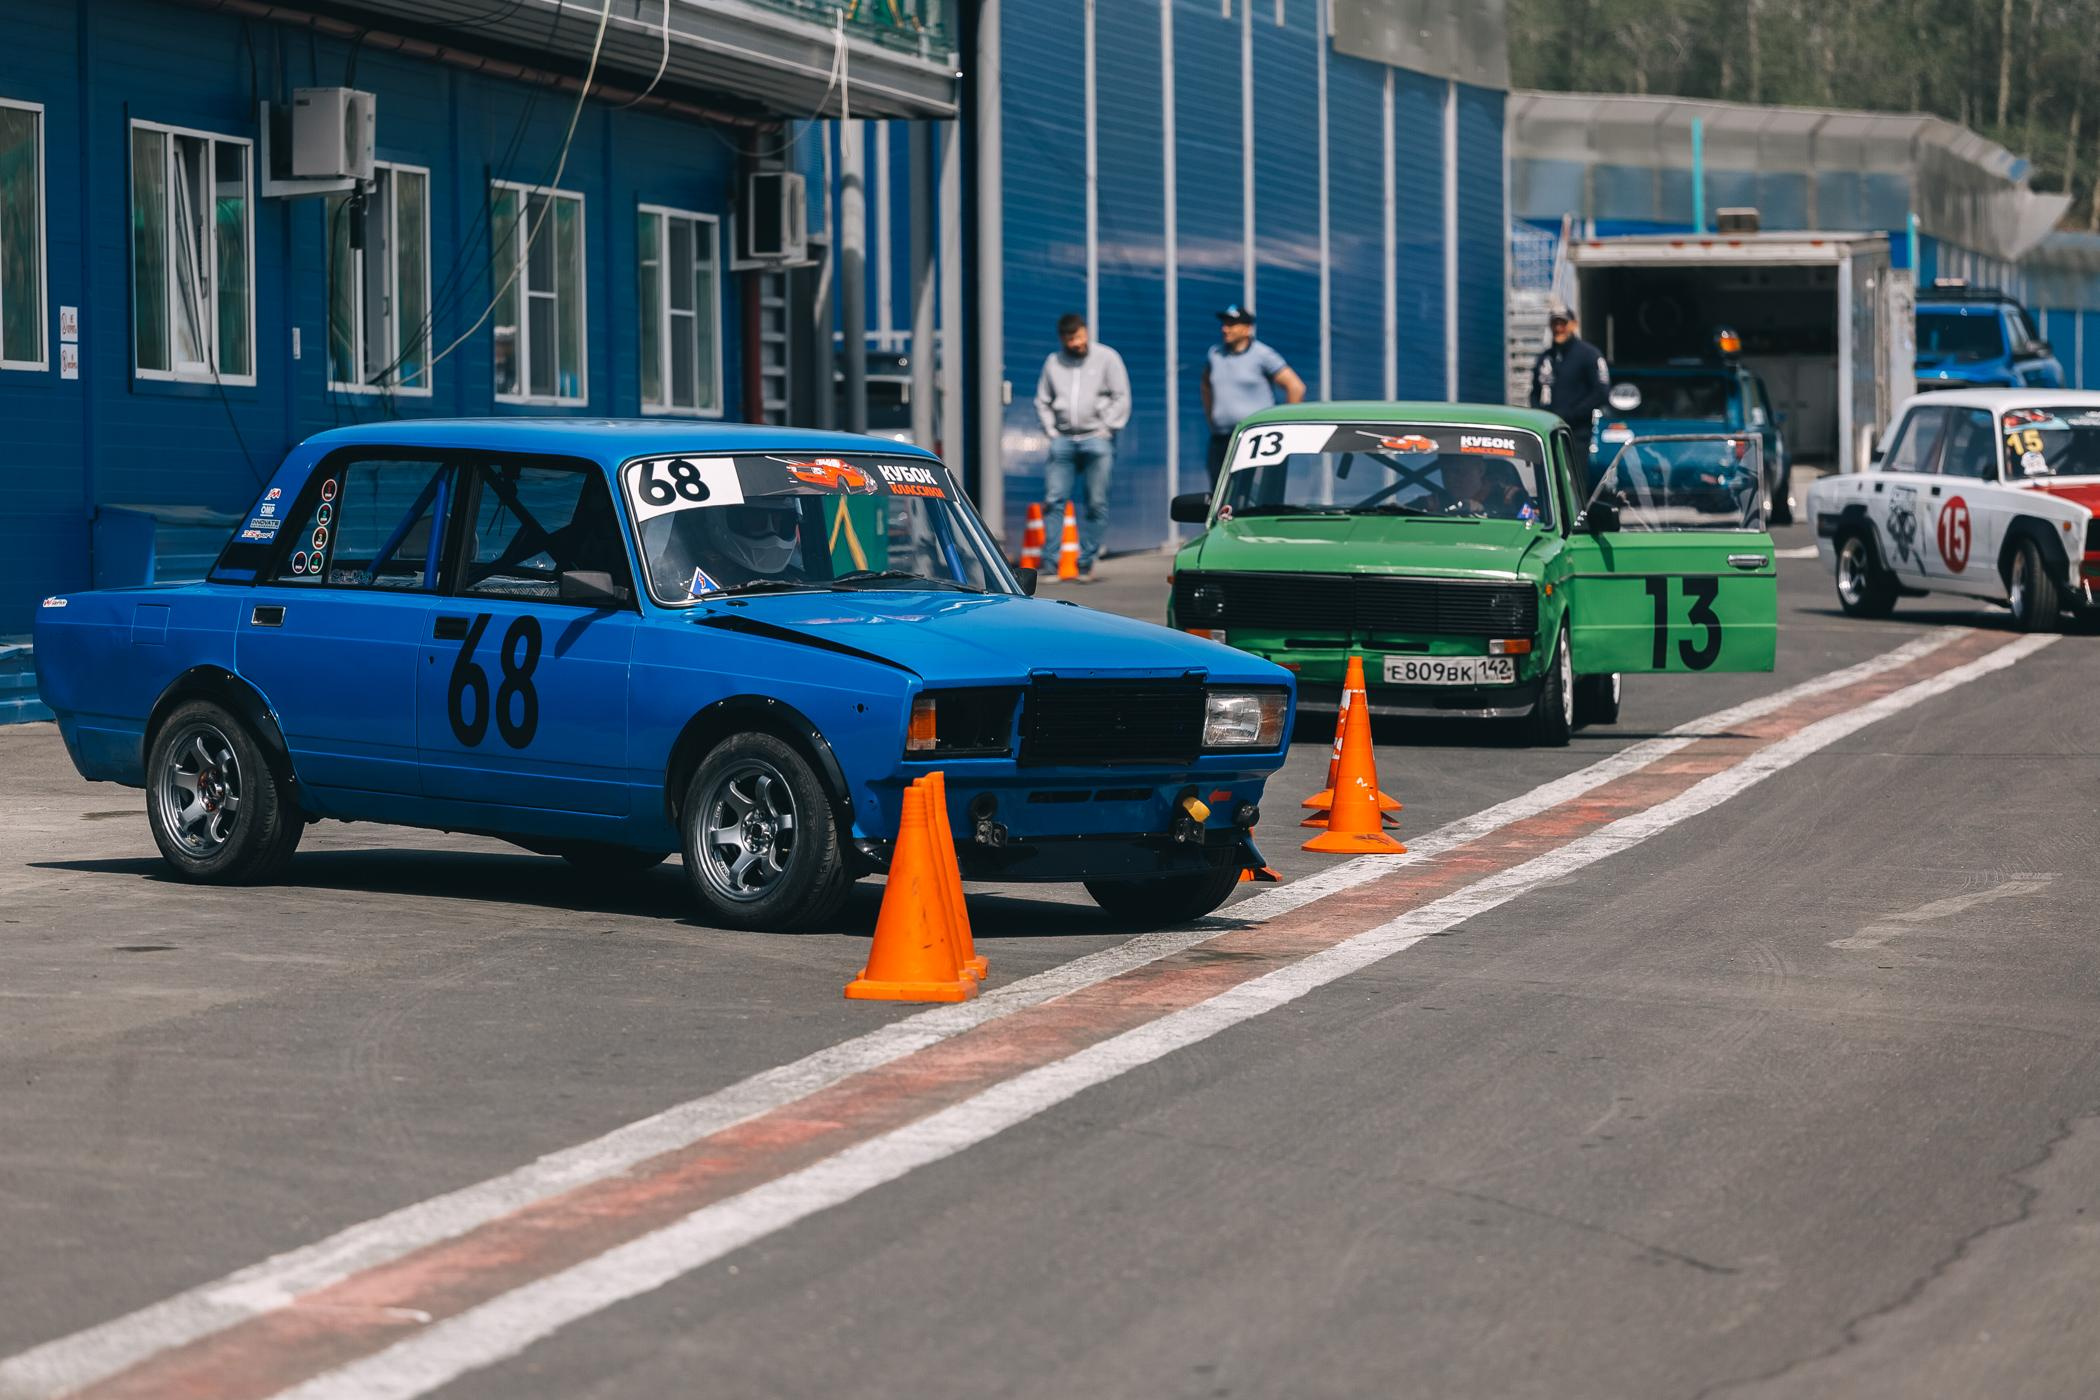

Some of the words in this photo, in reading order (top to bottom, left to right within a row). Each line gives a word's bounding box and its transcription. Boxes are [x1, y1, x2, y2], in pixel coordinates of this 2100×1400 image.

[1248, 431, 1284, 459] 13
[1460, 435, 1516, 450] КУБОК
[2007, 429, 2044, 455] 15
[639, 460, 711, 507] 68
[877, 464, 938, 485] КУБОК
[889, 483, 947, 499] КЛАССИКИ
[1942, 507, 1967, 562] 15
[1644, 575, 1722, 671] 13
[448, 613, 542, 749] 68
